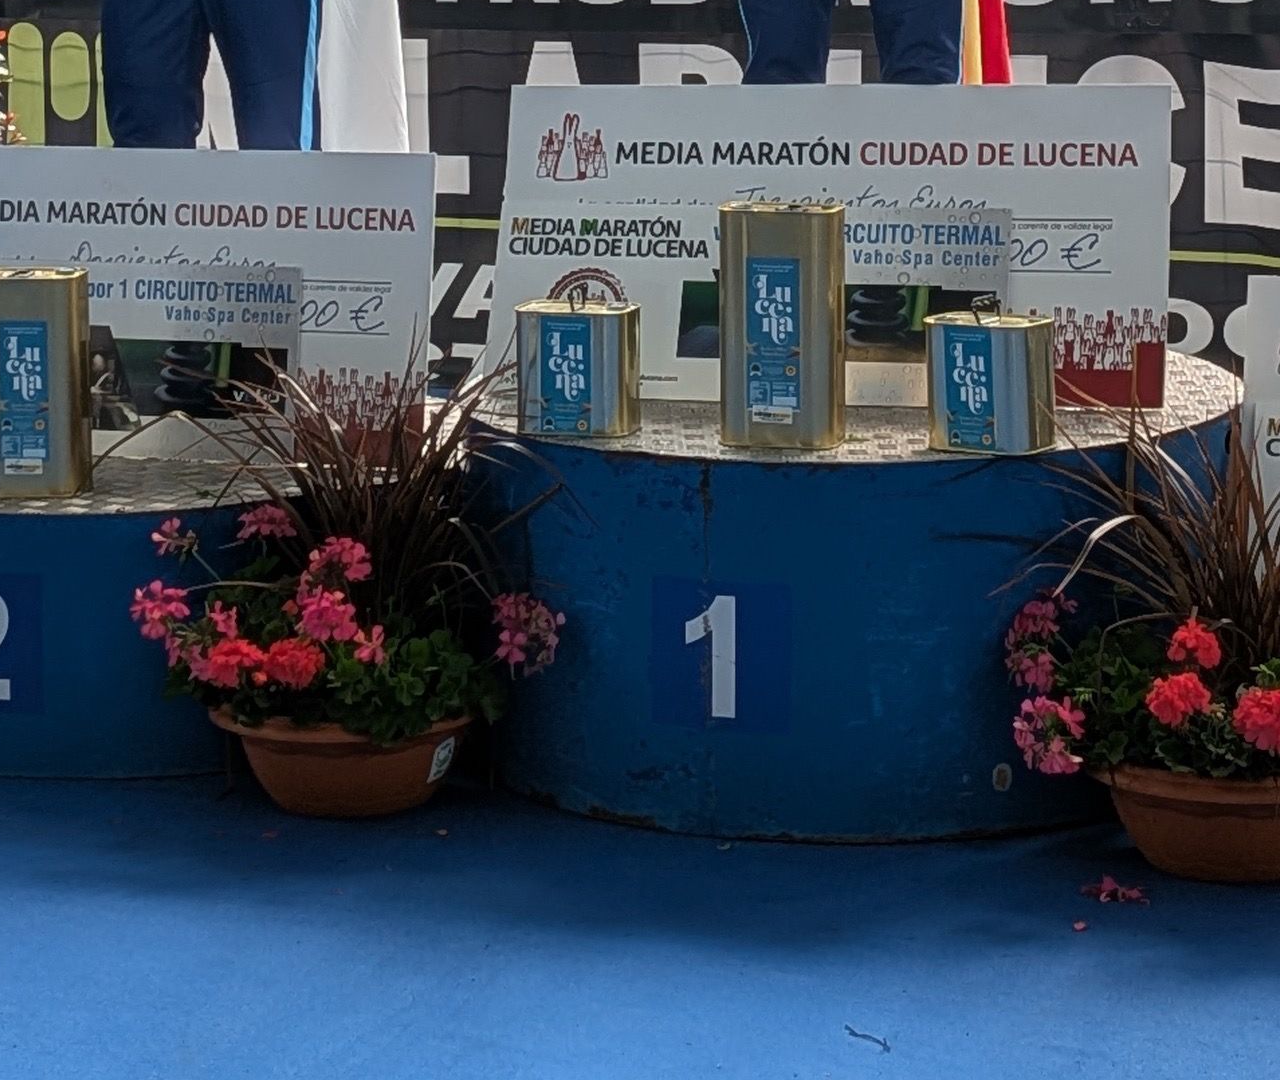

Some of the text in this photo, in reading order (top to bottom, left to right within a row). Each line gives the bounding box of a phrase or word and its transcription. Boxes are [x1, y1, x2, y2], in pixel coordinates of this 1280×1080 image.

[616, 136, 1139, 168] MEDIA MARATÓN CIUDAD DE LUCENA
[46, 197, 166, 226] MARATÓN
[174, 203, 268, 228] CIUDAD
[276, 206, 308, 229] DE
[316, 207, 416, 233] LUCENA
[510, 216, 681, 237] MEDIA MARATÓN
[843, 223, 1006, 248] RCUITO TERMAL
[509, 237, 710, 260] CIUDAD DE LUCENA
[852, 249, 1000, 269] Vaho Spa Center
[1060, 233, 1102, 270] €
[119, 280, 128, 298] 1
[135, 279, 218, 303] CIRCUITO
[224, 281, 297, 304] TERMAL
[165, 305, 292, 326] Vaho Spa Center
[300, 295, 385, 331] 00 €
[685, 595, 736, 718] 1
